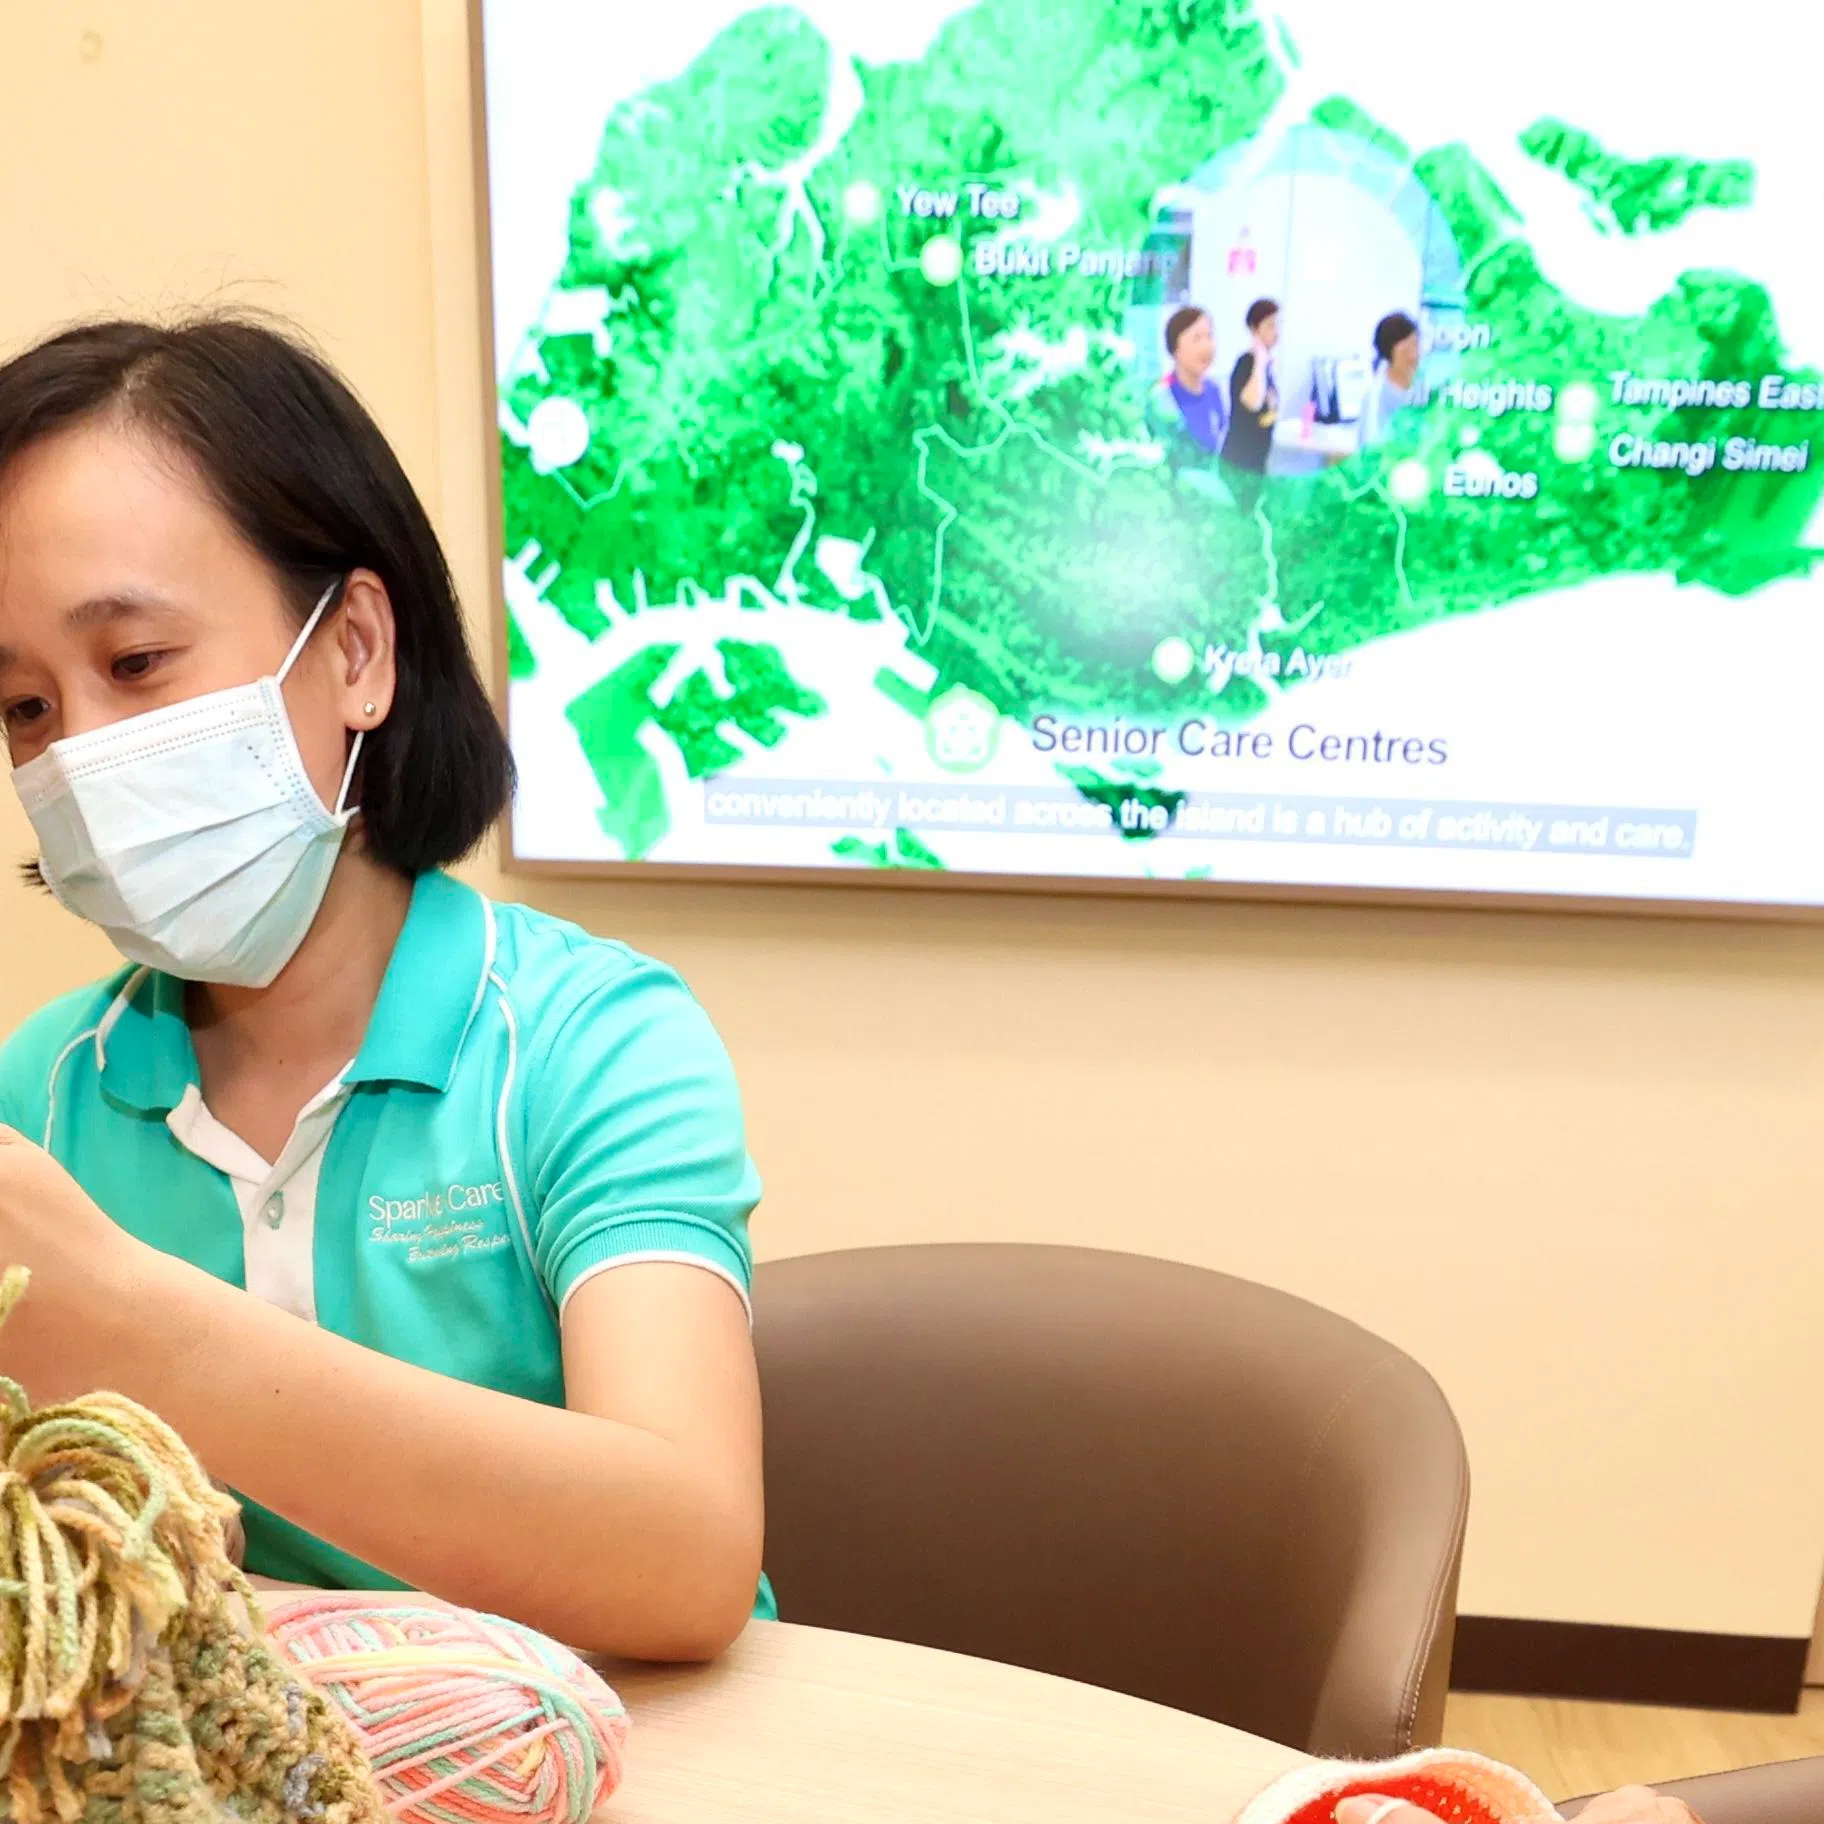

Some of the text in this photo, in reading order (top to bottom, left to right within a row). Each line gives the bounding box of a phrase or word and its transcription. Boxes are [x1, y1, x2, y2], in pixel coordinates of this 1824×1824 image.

[896, 182, 1021, 219] Yew Tee
[973, 238, 1051, 278] Bukit
[1440, 378, 1554, 417] Heights
[1609, 370, 1752, 413] Tampines
[1609, 432, 1810, 476] Changi Simei
[1443, 464, 1538, 499] Eunos
[1032, 714, 1449, 766] Senior Care Centres
[707, 790, 891, 828] conveniently
[898, 792, 1005, 826] located
[1013, 801, 1113, 829] across
[1120, 797, 1168, 831] the
[1176, 799, 1264, 833] island
[1273, 802, 1299, 834] is
[1305, 809, 1327, 836] a
[1335, 805, 1390, 838] hub
[1398, 807, 1432, 840] of
[1436, 808, 1542, 850] activity
[1548, 817, 1610, 846] and
[447, 1181, 504, 1211] Care
